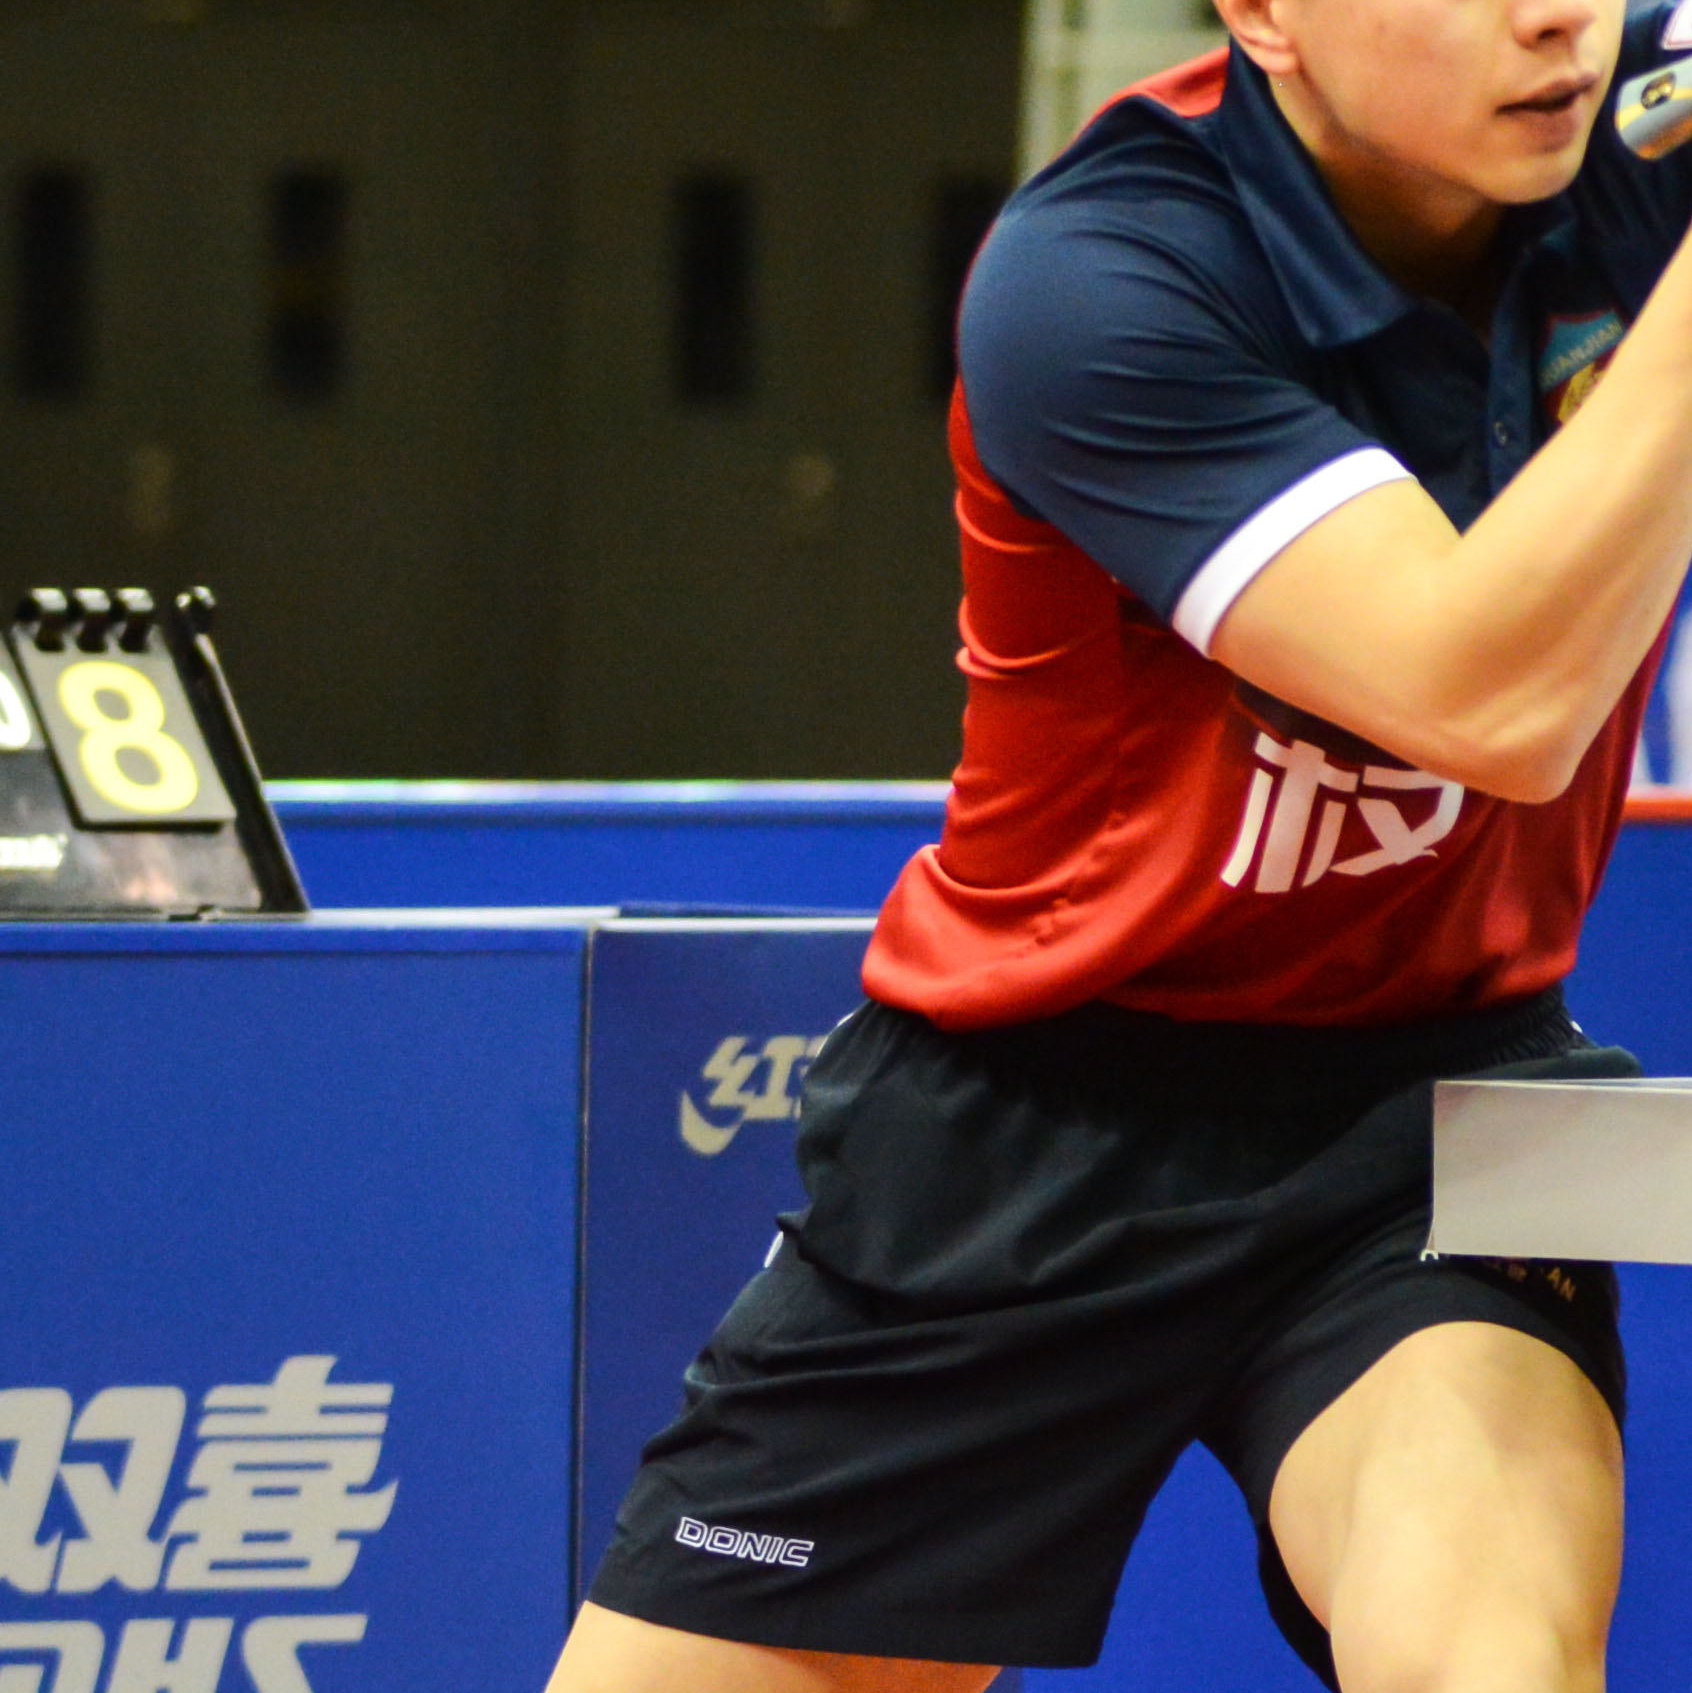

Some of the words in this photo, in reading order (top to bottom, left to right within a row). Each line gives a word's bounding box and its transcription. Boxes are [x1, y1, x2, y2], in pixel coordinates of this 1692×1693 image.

[58, 660, 199, 814] 8
[679, 1035, 829, 1156] 红
[675, 1516, 815, 1567] DONIC
